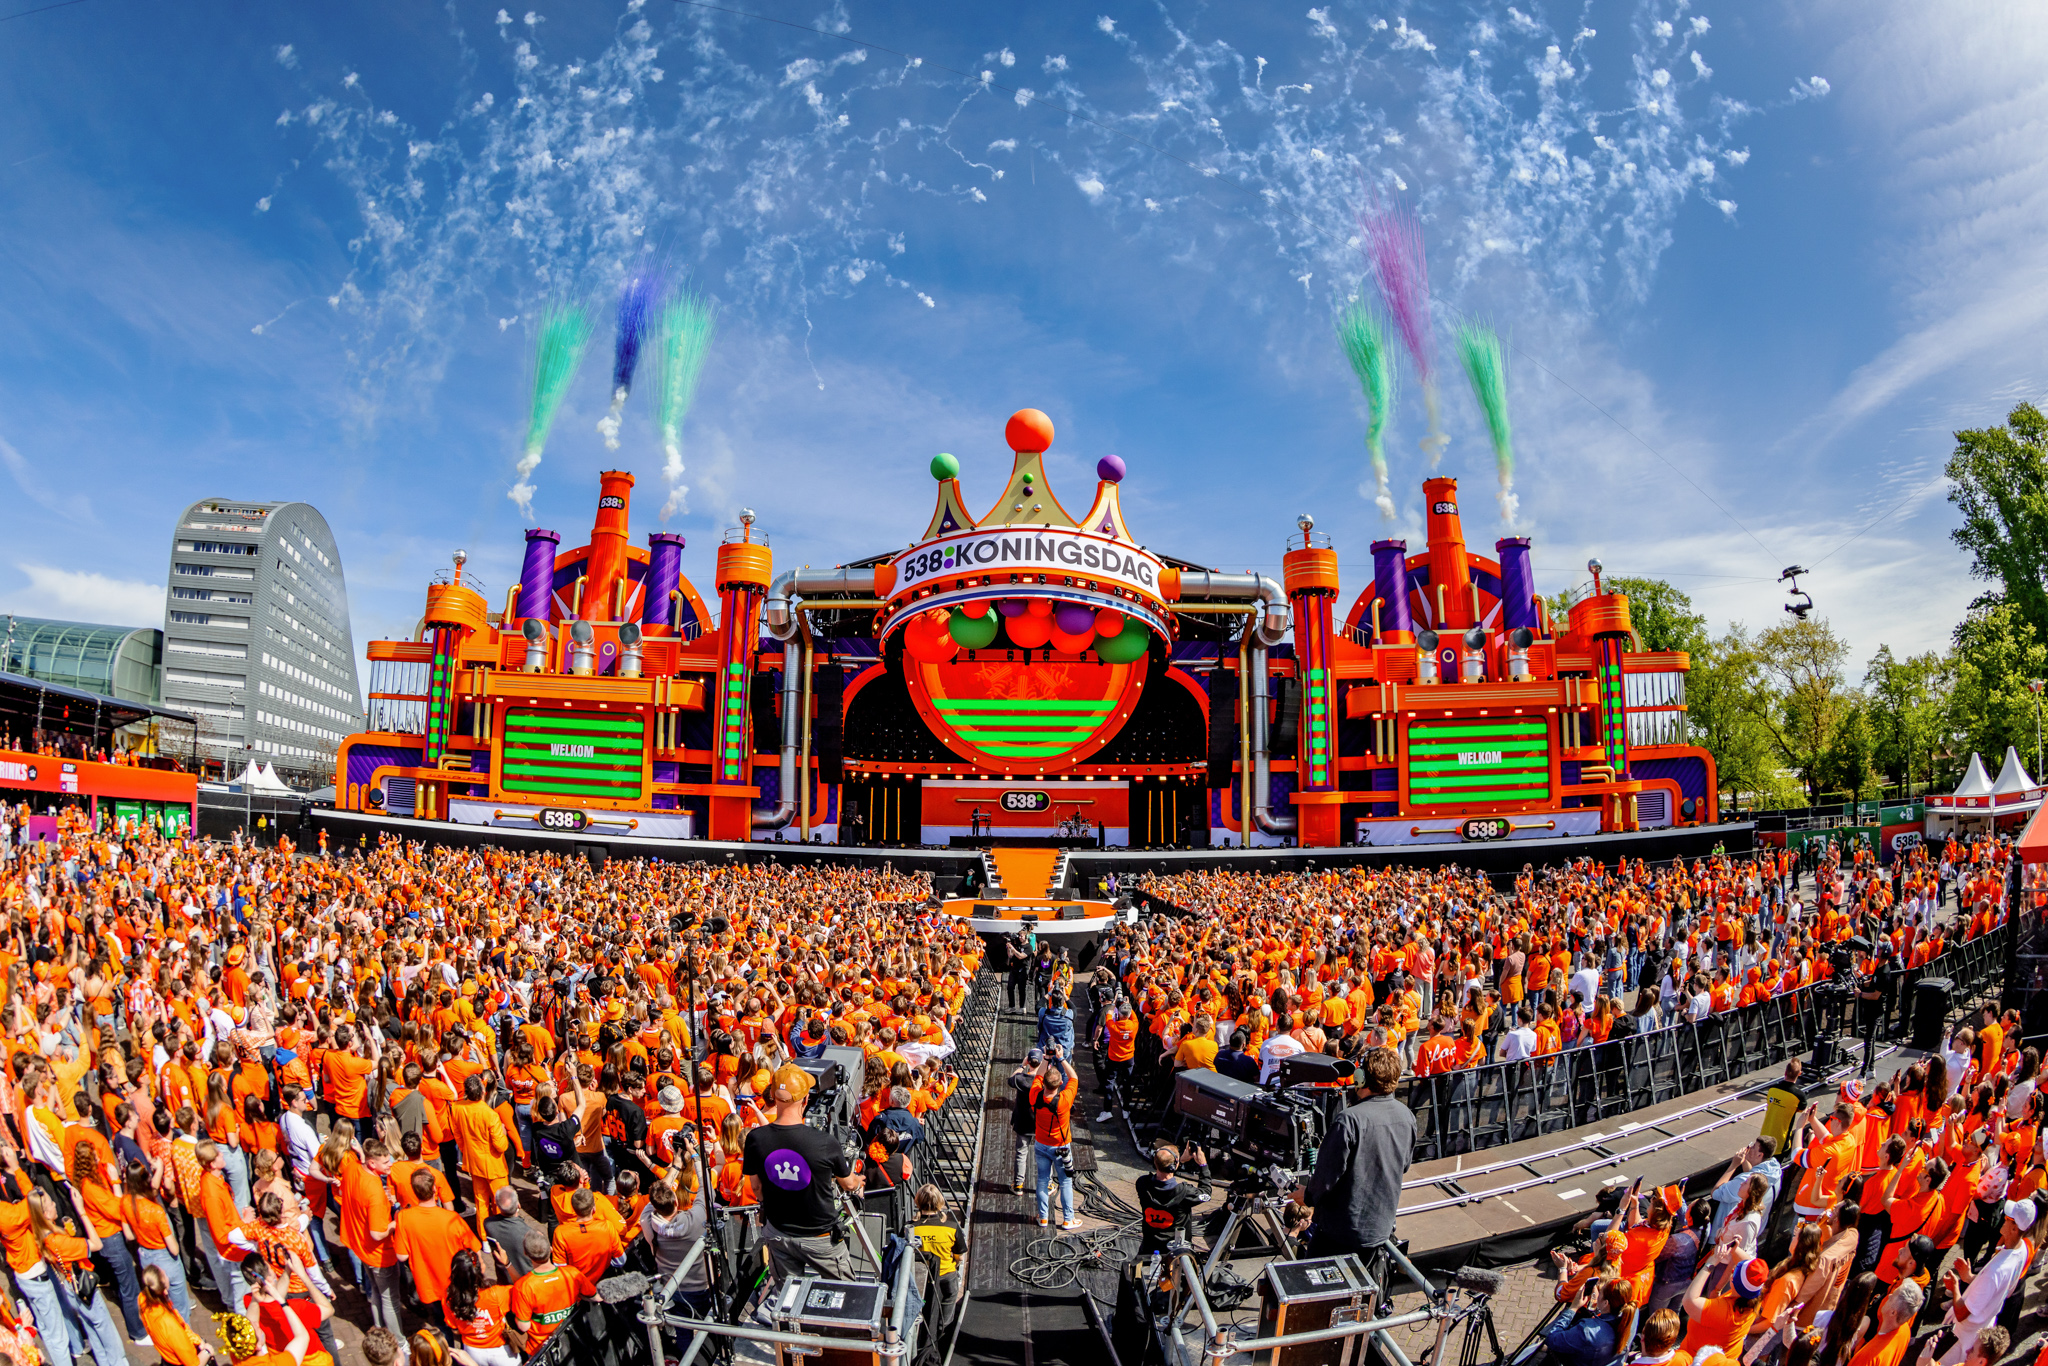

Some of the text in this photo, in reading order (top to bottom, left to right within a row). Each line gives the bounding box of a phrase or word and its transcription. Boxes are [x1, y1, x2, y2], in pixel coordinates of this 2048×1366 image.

[600, 497, 619, 508] 538
[1435, 503, 1455, 514] 538
[955, 537, 1154, 588] KONINGSDAG
[550, 743, 595, 758] WELKOM
[1457, 751, 1502, 765] WELKOM
[1007, 793, 1037, 808] 538
[545, 811, 574, 827] 538
[1468, 821, 1498, 838] 538
[1895, 833, 1914, 849] 538
